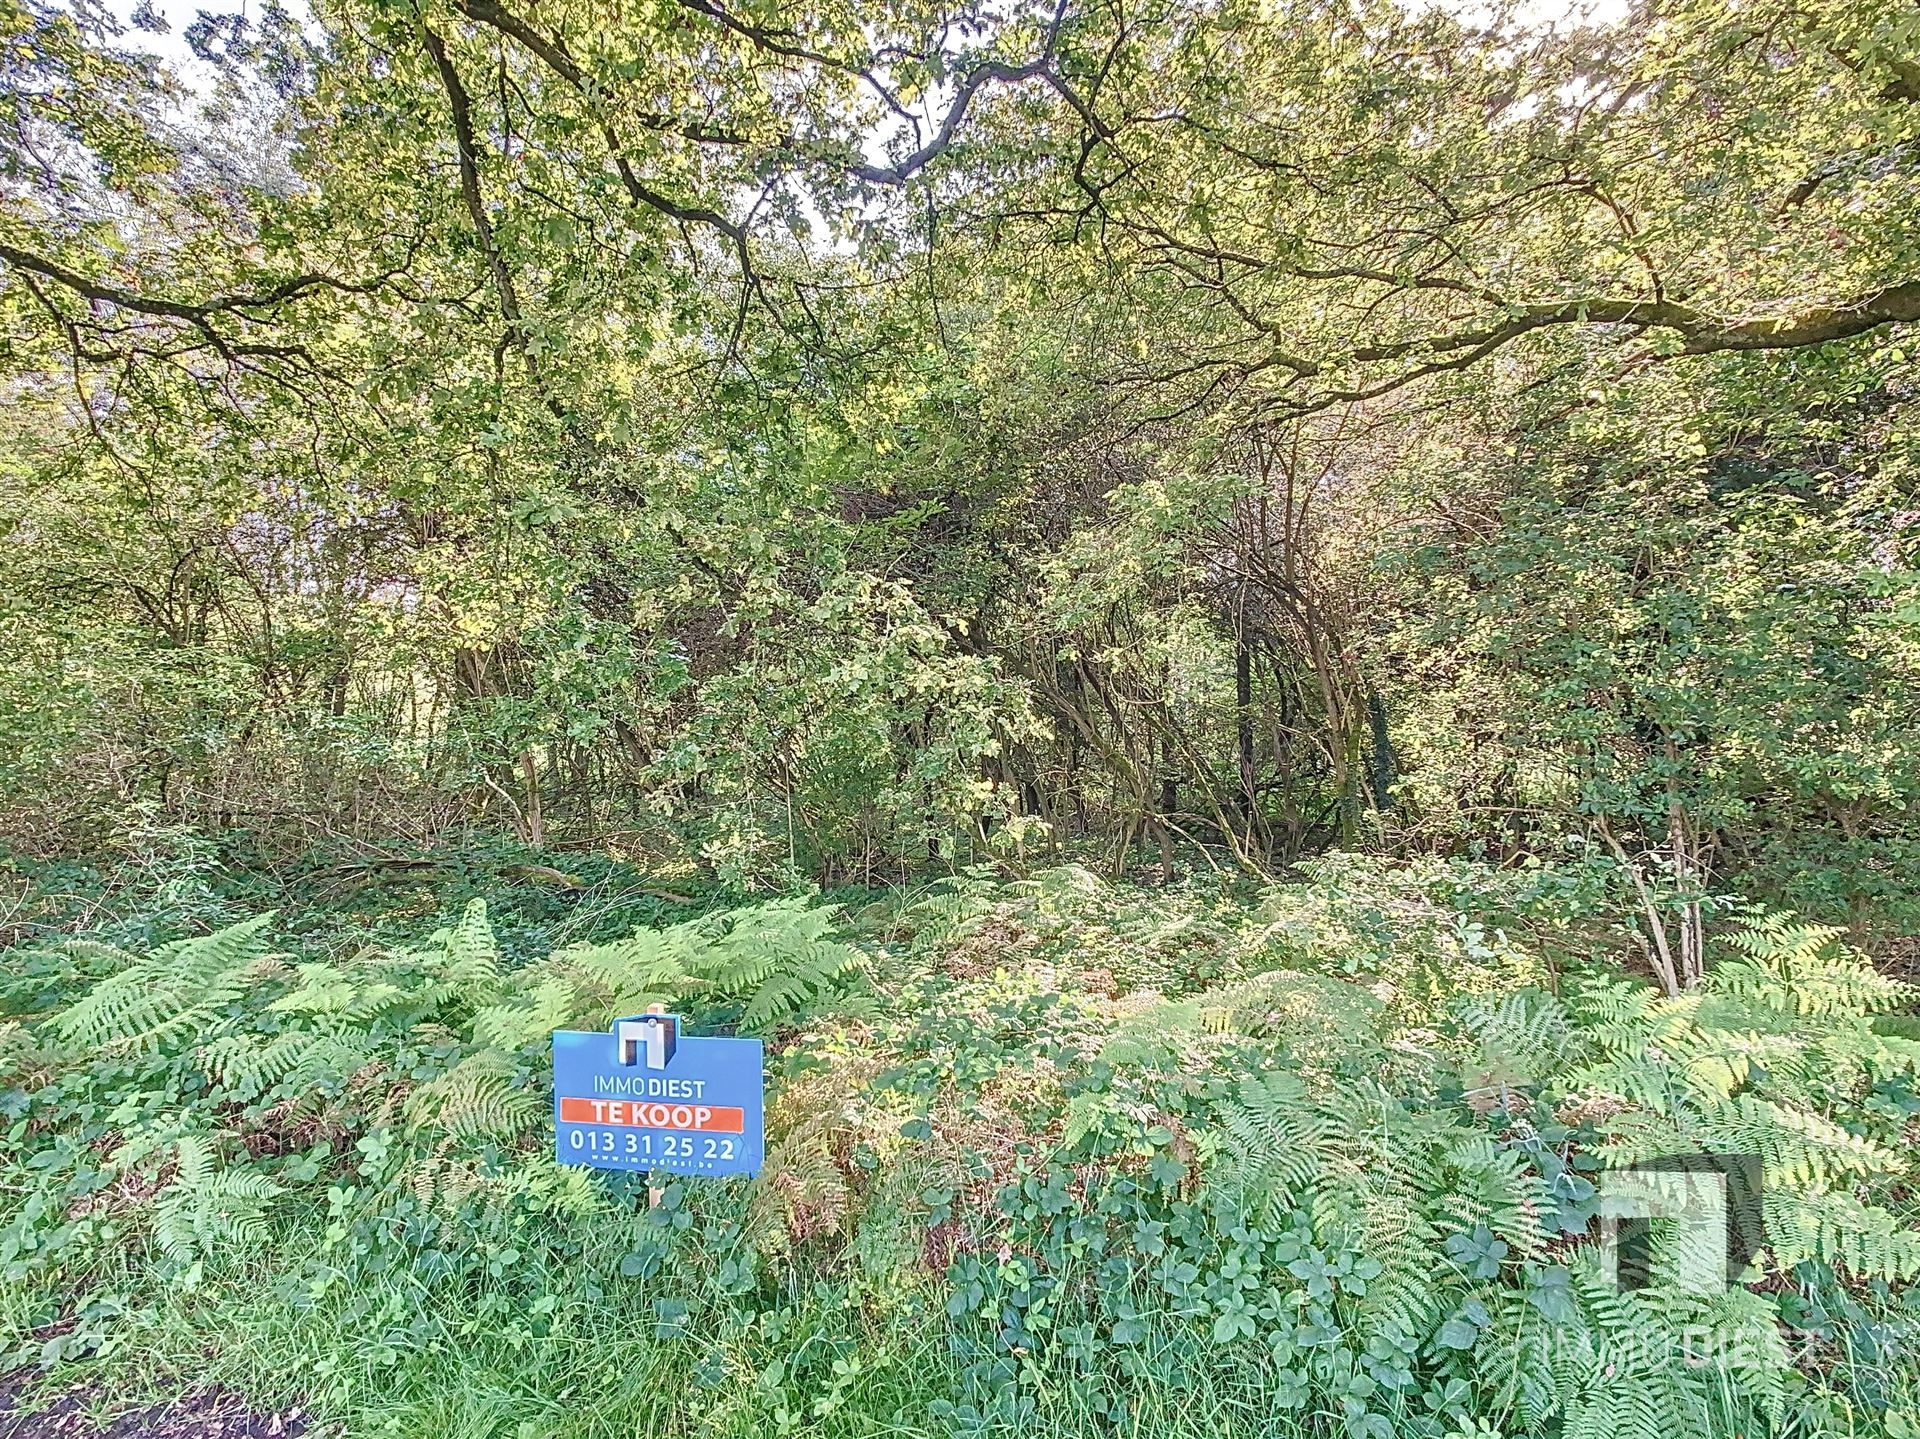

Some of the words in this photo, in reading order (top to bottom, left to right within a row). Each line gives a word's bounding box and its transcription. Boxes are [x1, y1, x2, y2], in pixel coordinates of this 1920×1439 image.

[594, 1075, 645, 1096] IMMO
[649, 1078, 706, 1099] DIEST
[591, 1100, 624, 1123] TE
[631, 1104, 712, 1128] KOOP
[570, 1130, 616, 1151] 013
[625, 1134, 652, 1154] 31
[663, 1136, 694, 1157] 25
[703, 1139, 735, 1160] 22
